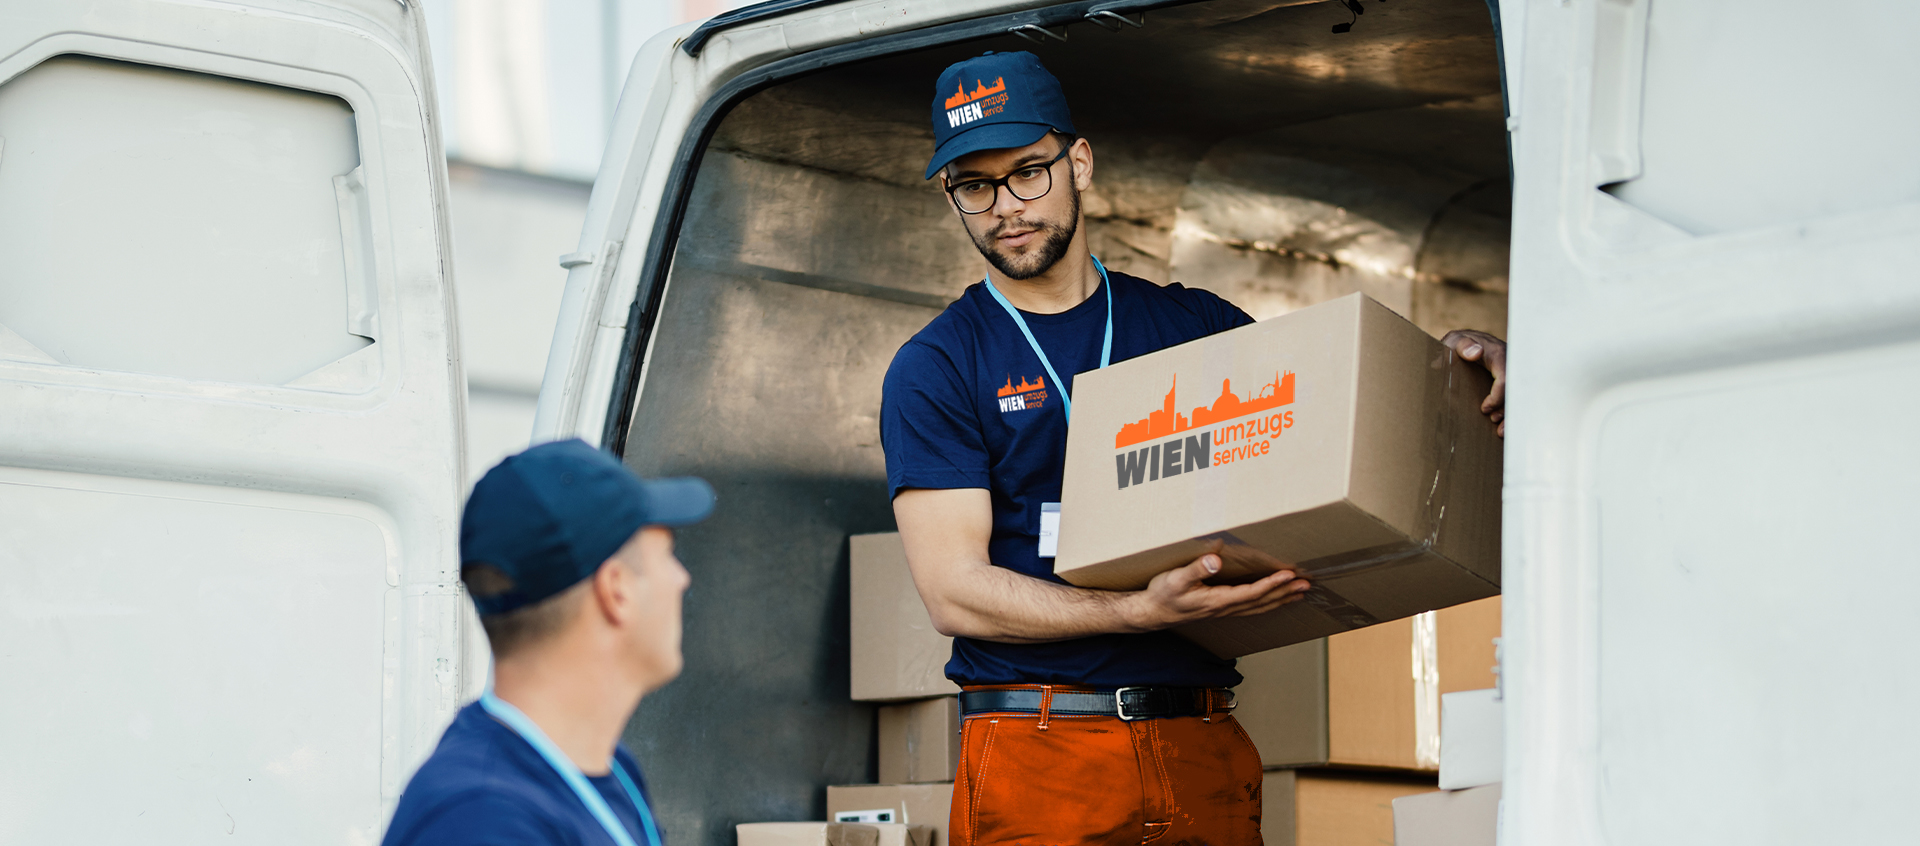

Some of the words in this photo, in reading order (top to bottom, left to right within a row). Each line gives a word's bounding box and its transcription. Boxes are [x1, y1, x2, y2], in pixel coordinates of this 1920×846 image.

[980, 92, 1009, 108] umzugs
[983, 105, 1004, 117] service
[947, 101, 983, 128] WIEN
[998, 395, 1025, 413] WIEN
[1213, 411, 1295, 446] umzugs
[1116, 431, 1211, 490] WIEN
[1213, 439, 1270, 467] service
